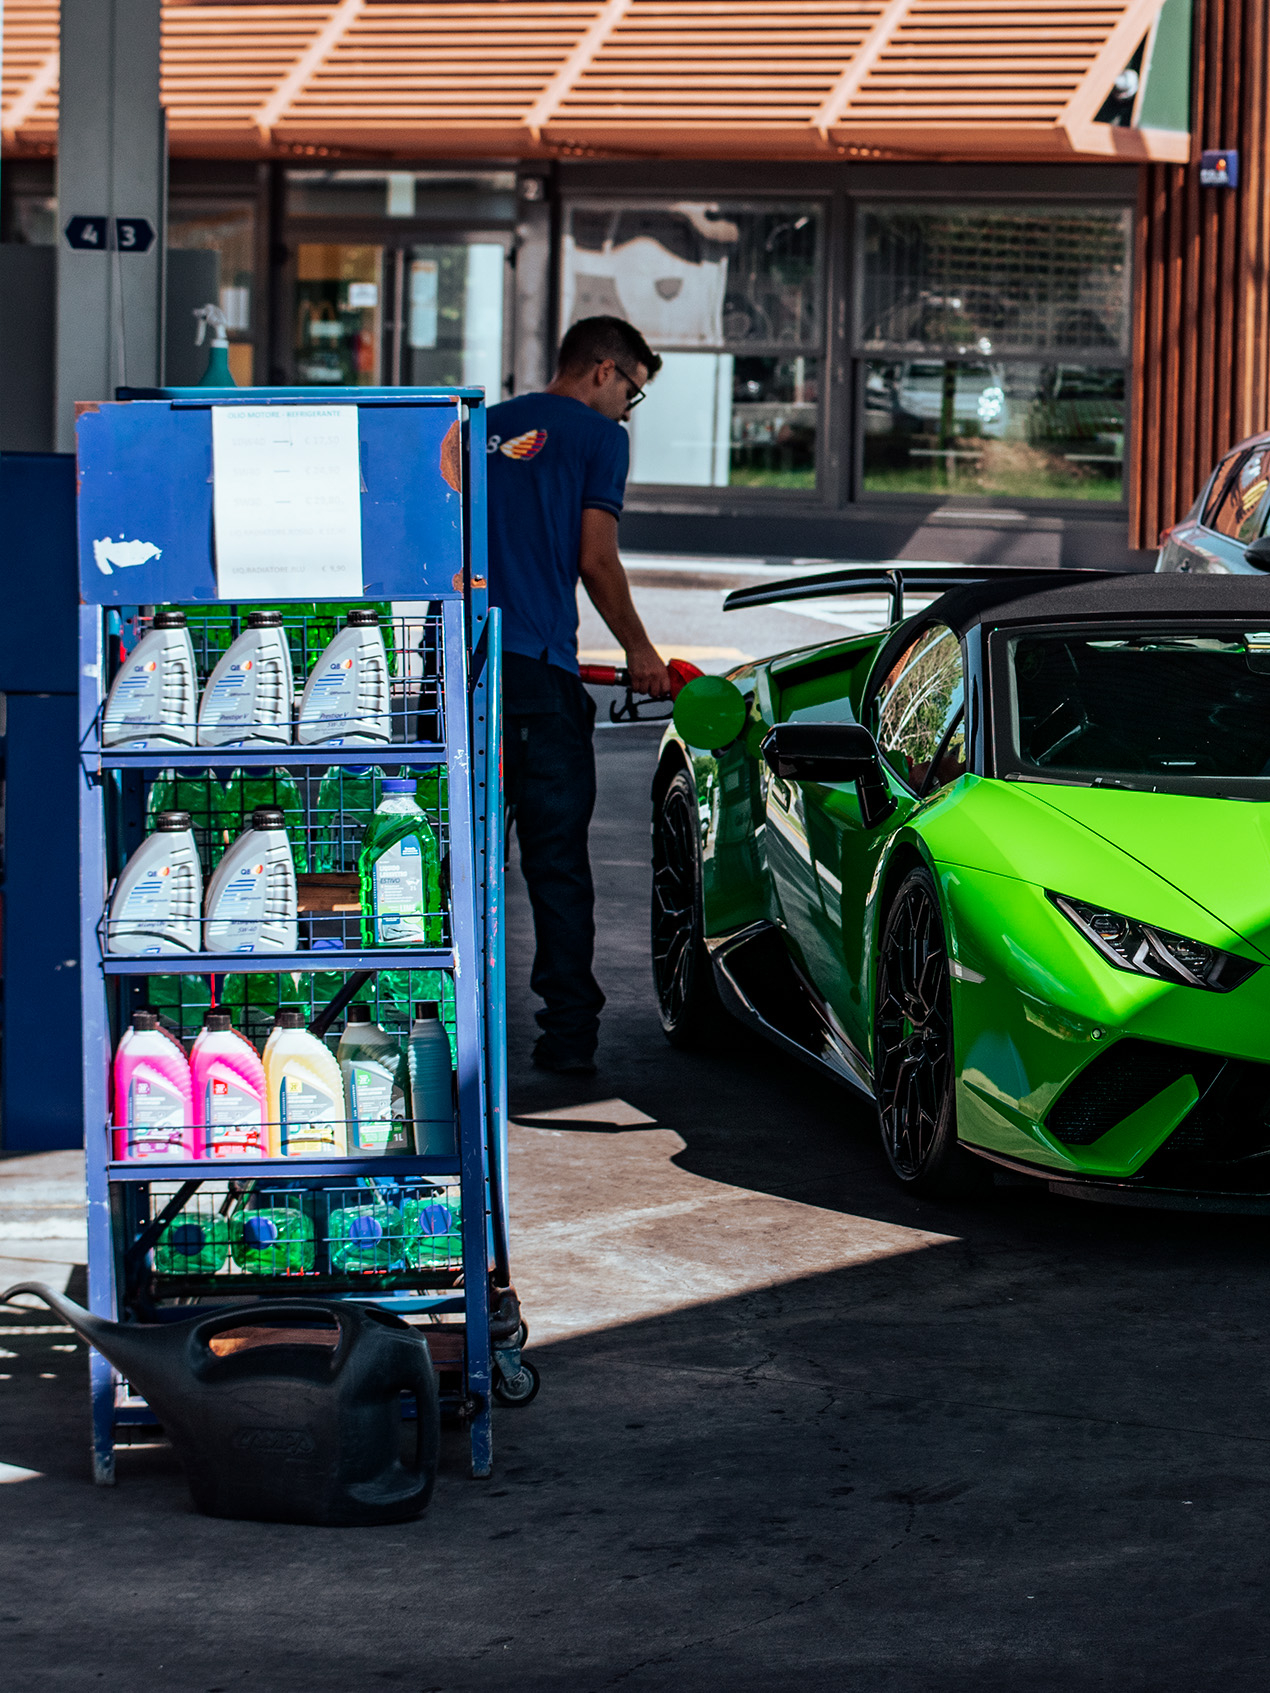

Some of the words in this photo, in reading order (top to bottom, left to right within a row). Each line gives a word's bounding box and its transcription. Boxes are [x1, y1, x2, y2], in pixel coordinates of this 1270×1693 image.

[81, 223, 98, 244] 4
[121, 225, 137, 247] 3
[226, 411, 245, 419] OLIO
[286, 410, 341, 418] REFRIGERANTE
[400, 904, 417, 912] LIME
[394, 1134, 404, 1142] 1L
